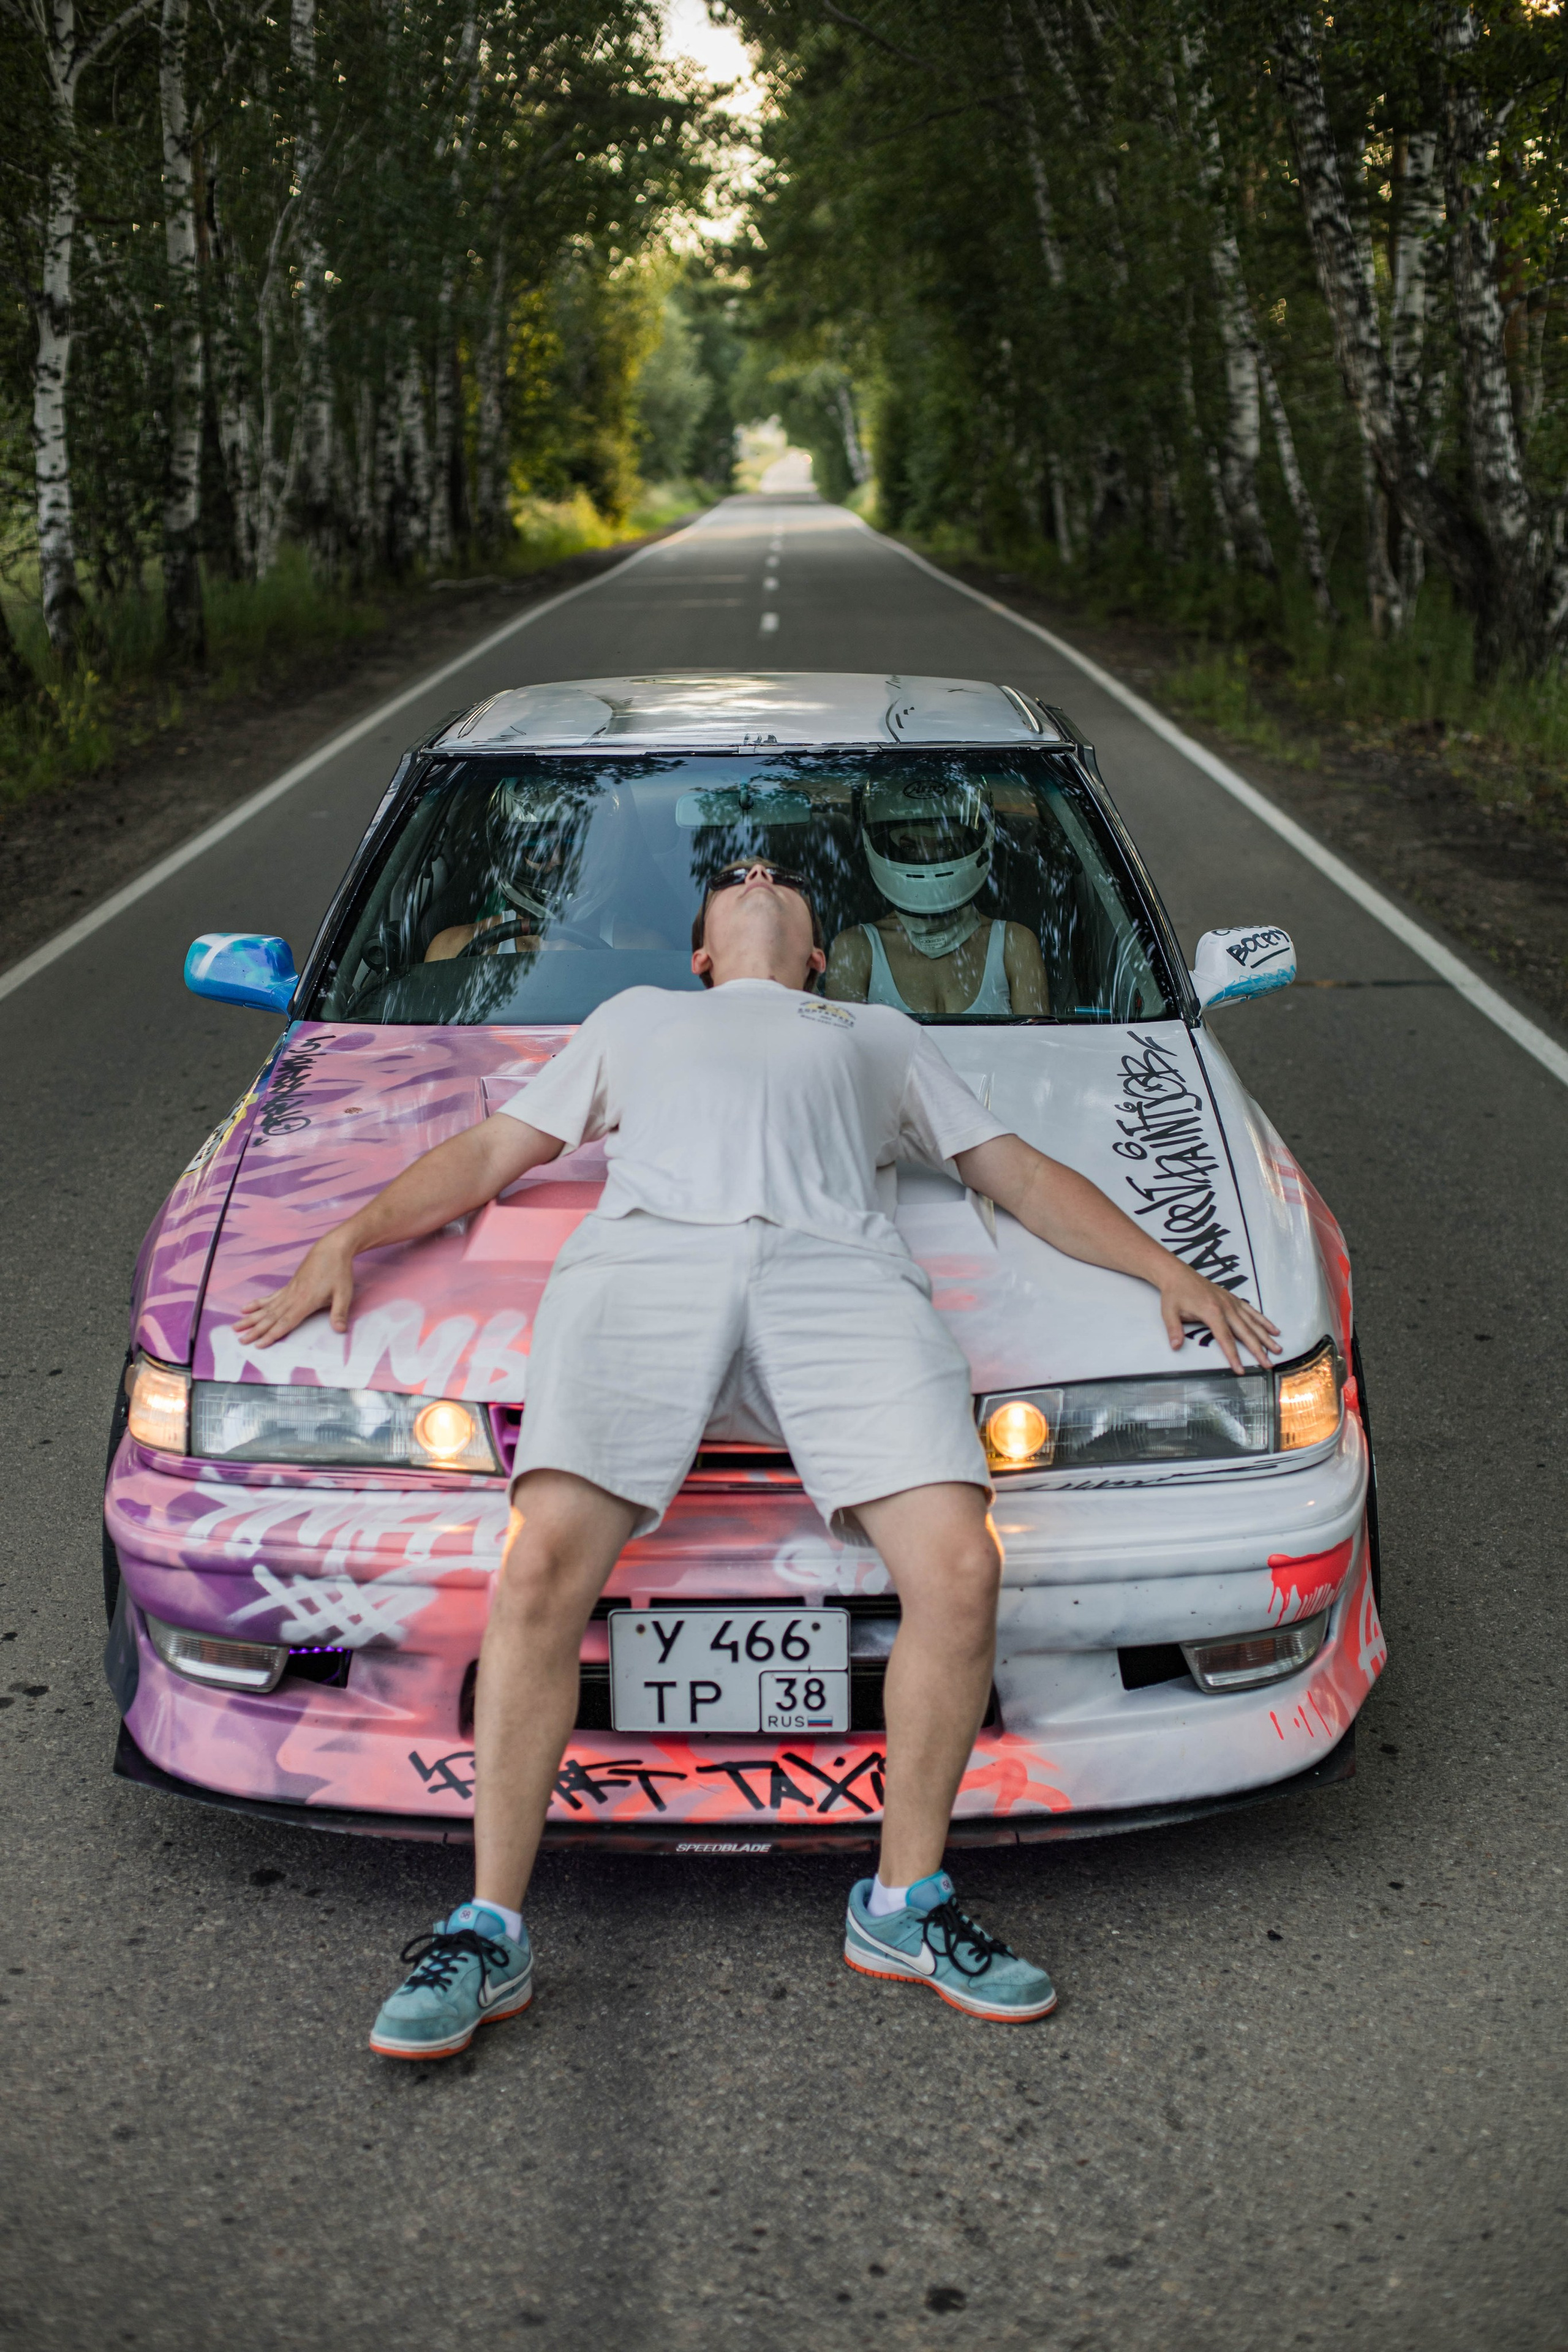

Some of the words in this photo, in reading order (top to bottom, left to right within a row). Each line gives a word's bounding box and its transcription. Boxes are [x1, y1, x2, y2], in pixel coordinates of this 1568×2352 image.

[710, 1619, 810, 1663] 466
[775, 1678, 826, 1711] 38
[767, 1716, 805, 1728] RUS
[676, 1842, 772, 1853] SPEEDBLADE
